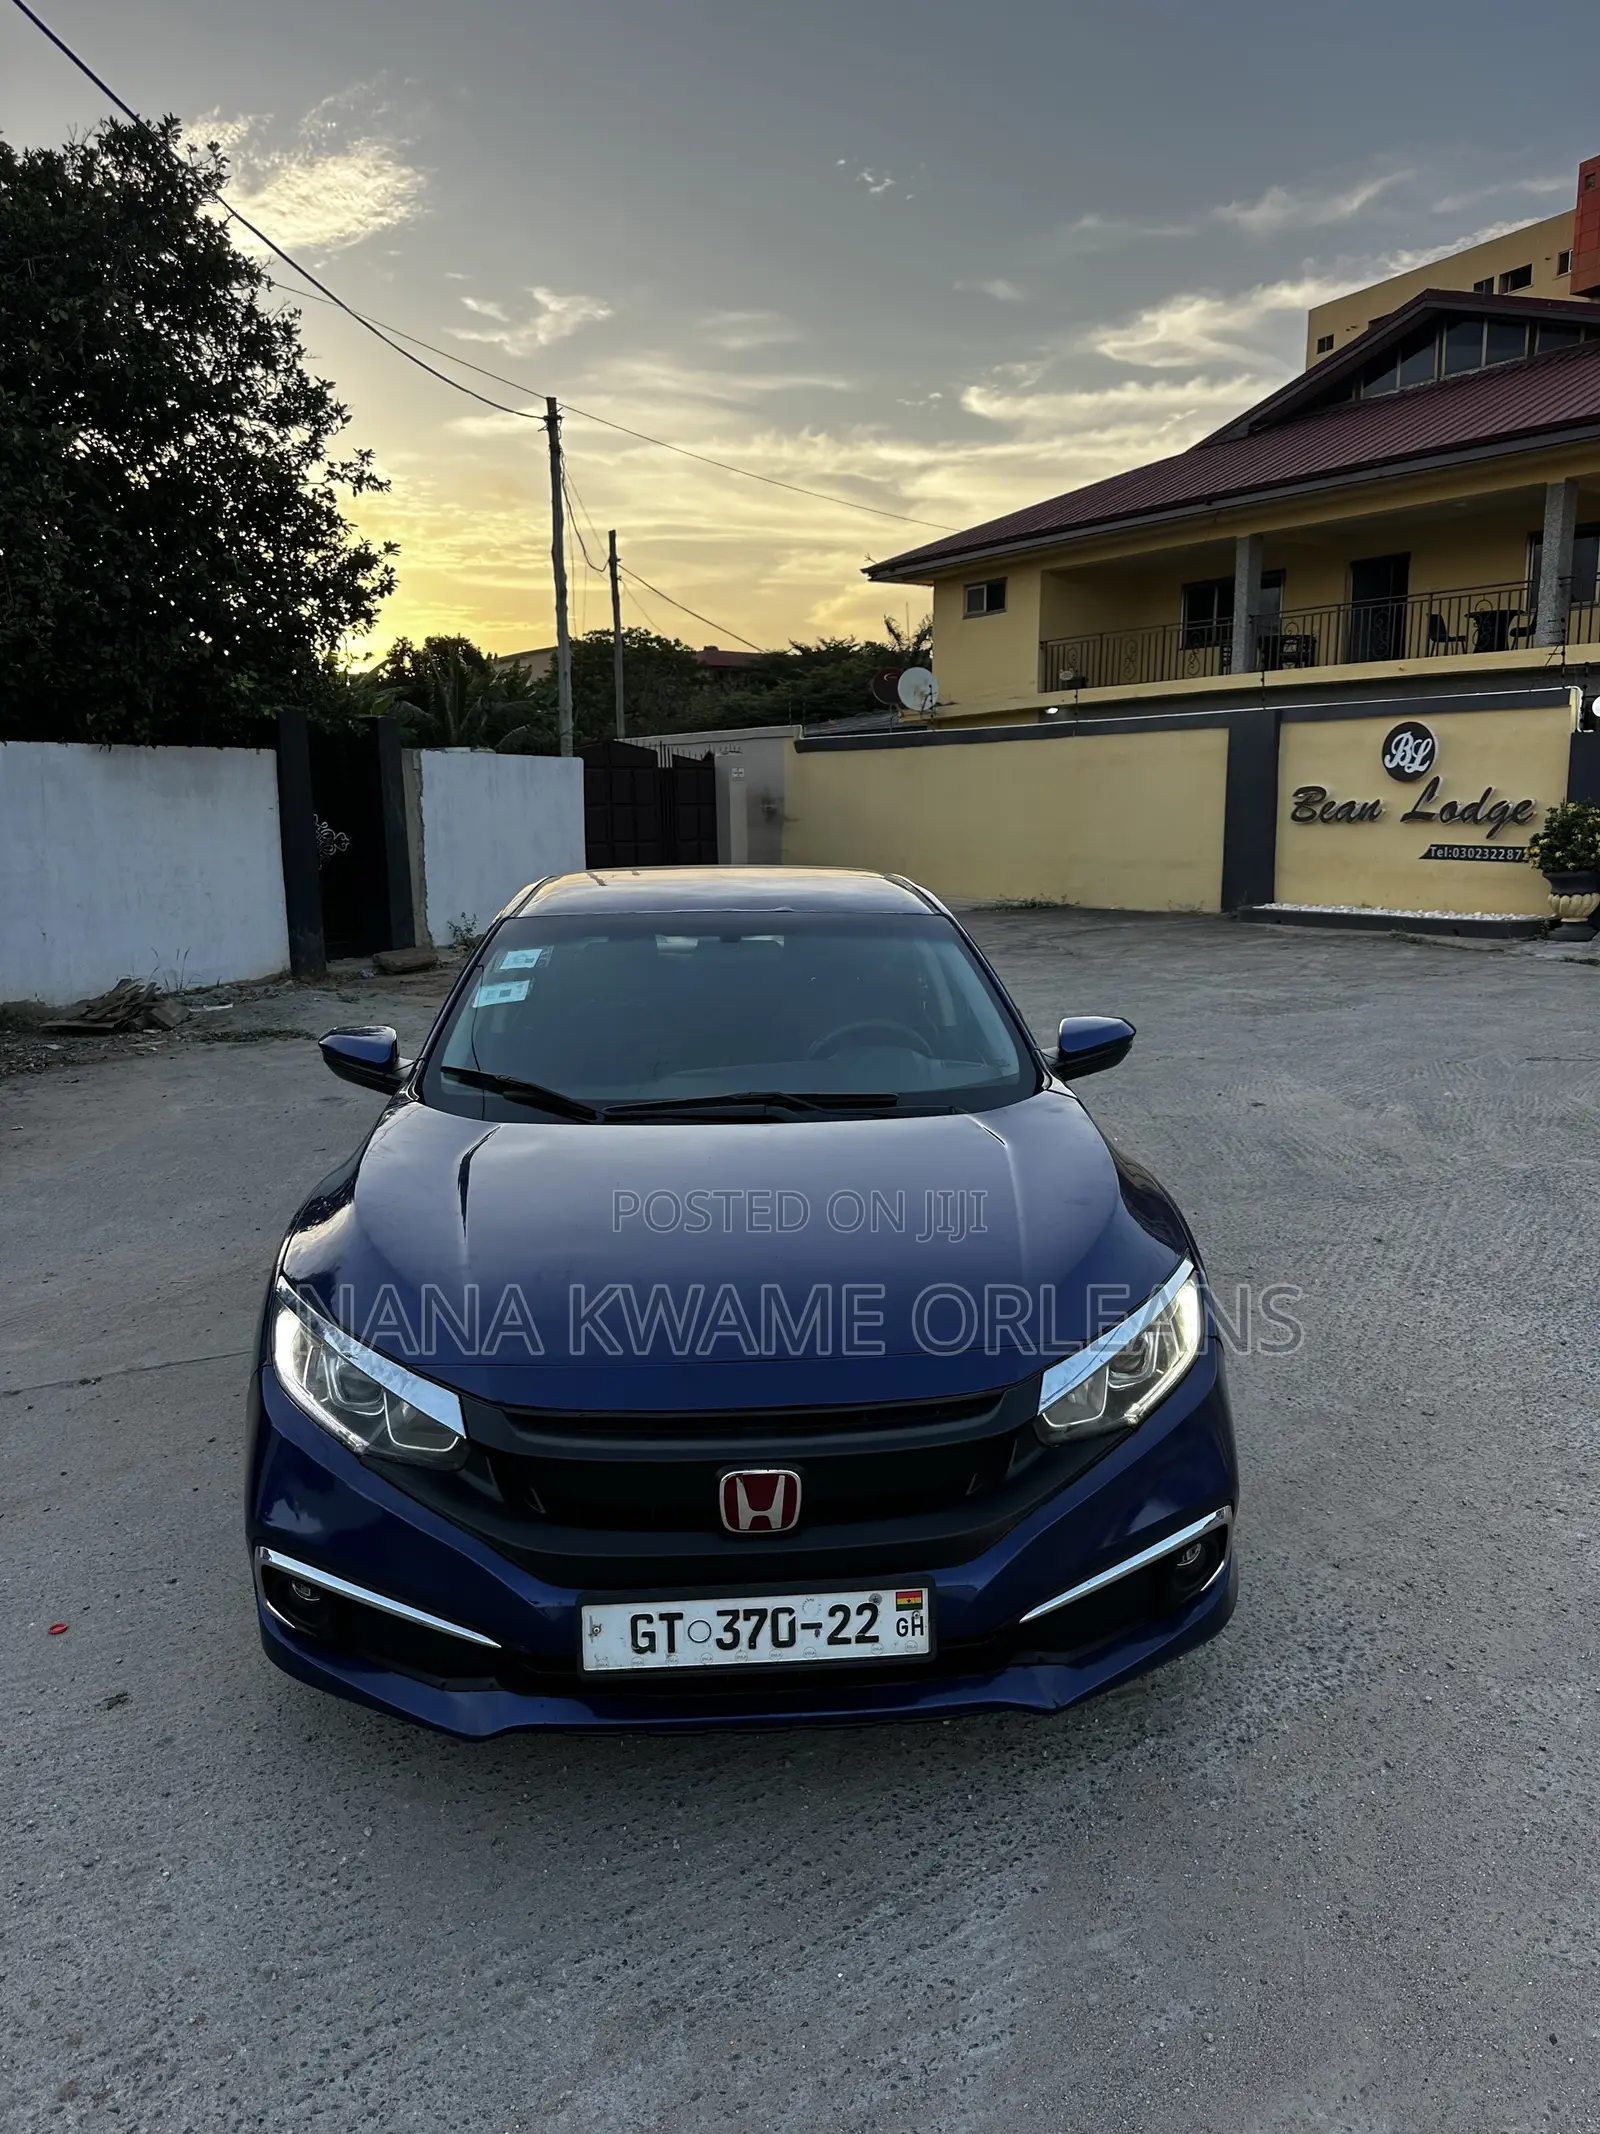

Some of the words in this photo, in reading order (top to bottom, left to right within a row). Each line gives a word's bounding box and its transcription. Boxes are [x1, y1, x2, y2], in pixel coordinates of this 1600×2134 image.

[1290, 785, 1384, 824] Bean
[1400, 775, 1537, 840] Lodge
[629, 1611, 684, 1654] GT
[715, 1602, 880, 1651] 370-22
[896, 1615, 924, 1637] GH
